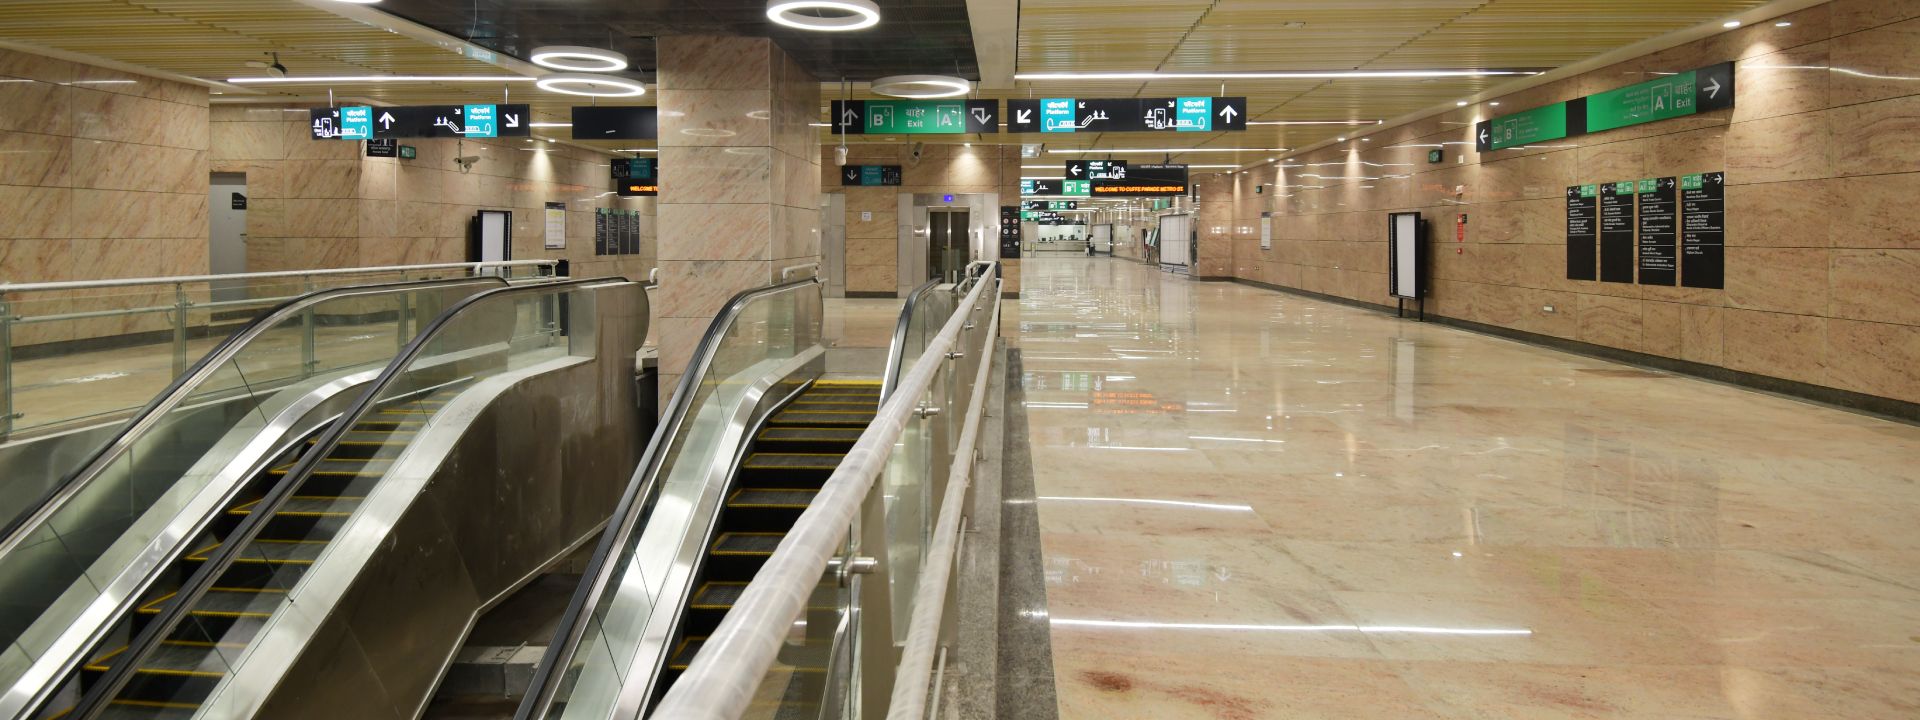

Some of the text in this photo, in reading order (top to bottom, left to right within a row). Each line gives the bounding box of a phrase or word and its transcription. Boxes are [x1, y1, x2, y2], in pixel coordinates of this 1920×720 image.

[1655, 96, 1664, 111] A
[1676, 97, 1691, 109] Exit
[873, 114, 884, 126] B
[907, 120, 923, 128] Exit
[941, 113, 952, 126] A
[1506, 128, 1512, 140] B
